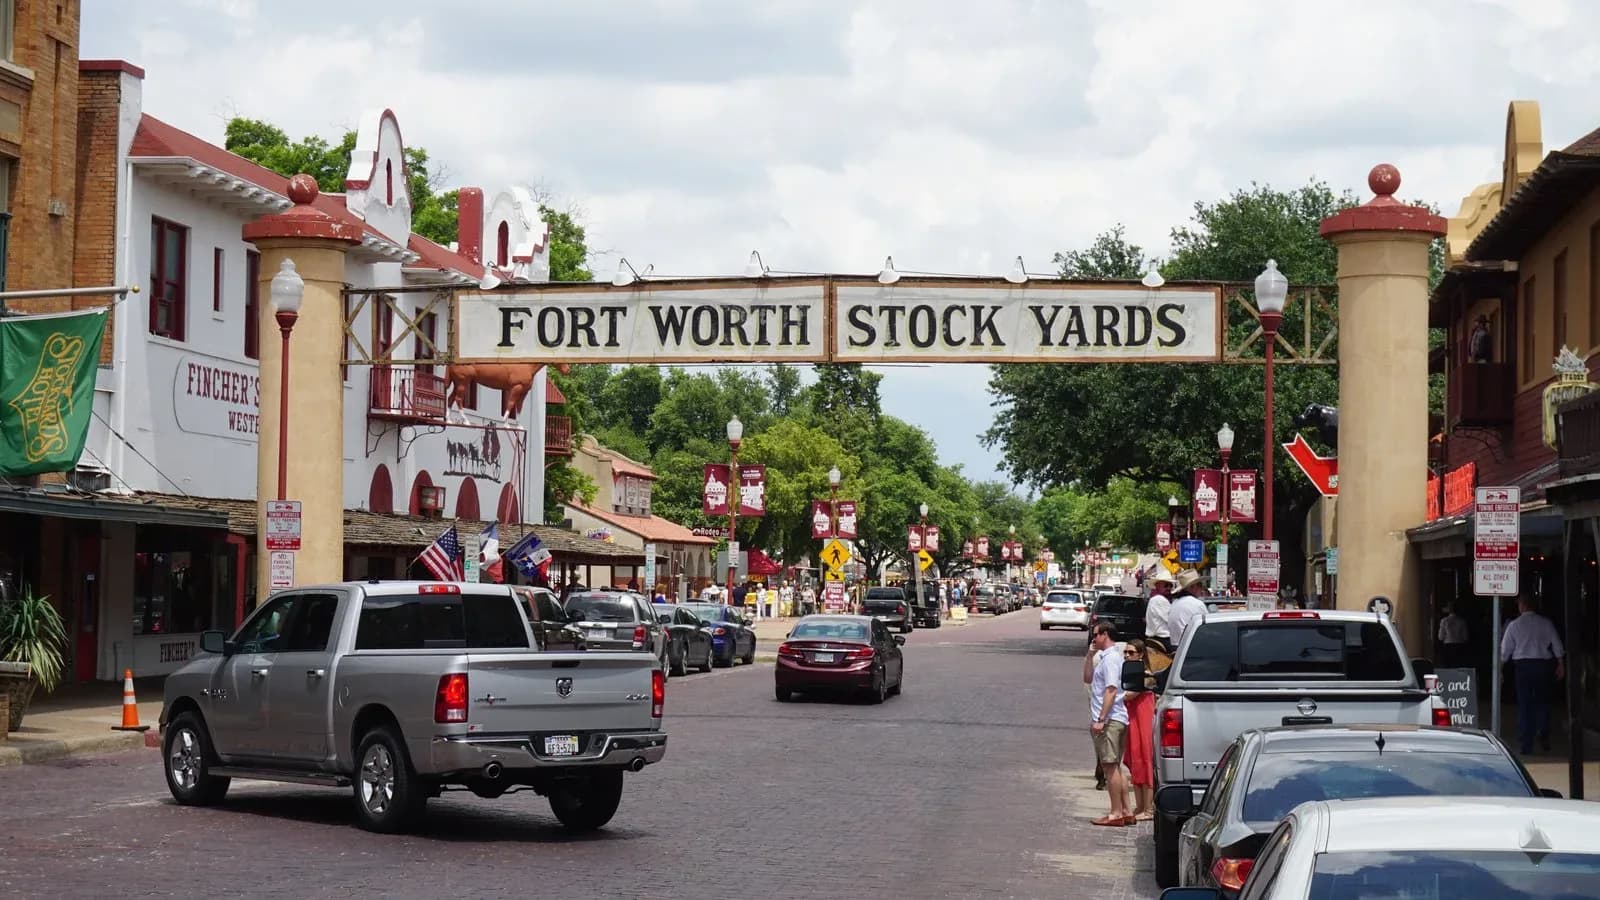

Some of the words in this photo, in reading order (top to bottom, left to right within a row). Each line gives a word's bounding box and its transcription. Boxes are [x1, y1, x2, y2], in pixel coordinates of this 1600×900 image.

[497, 306, 627, 348] FORT
[648, 304, 812, 347] WORTH
[847, 304, 1006, 348] STOCK
[1028, 303, 1187, 348] YARDS
[22, 367, 54, 429] HOTEL
[30, 337, 82, 456] STOCKYARDS
[187, 362, 260, 409] FINCHER'S
[1448, 675, 1471, 691] and
[1448, 697, 1468, 709] are
